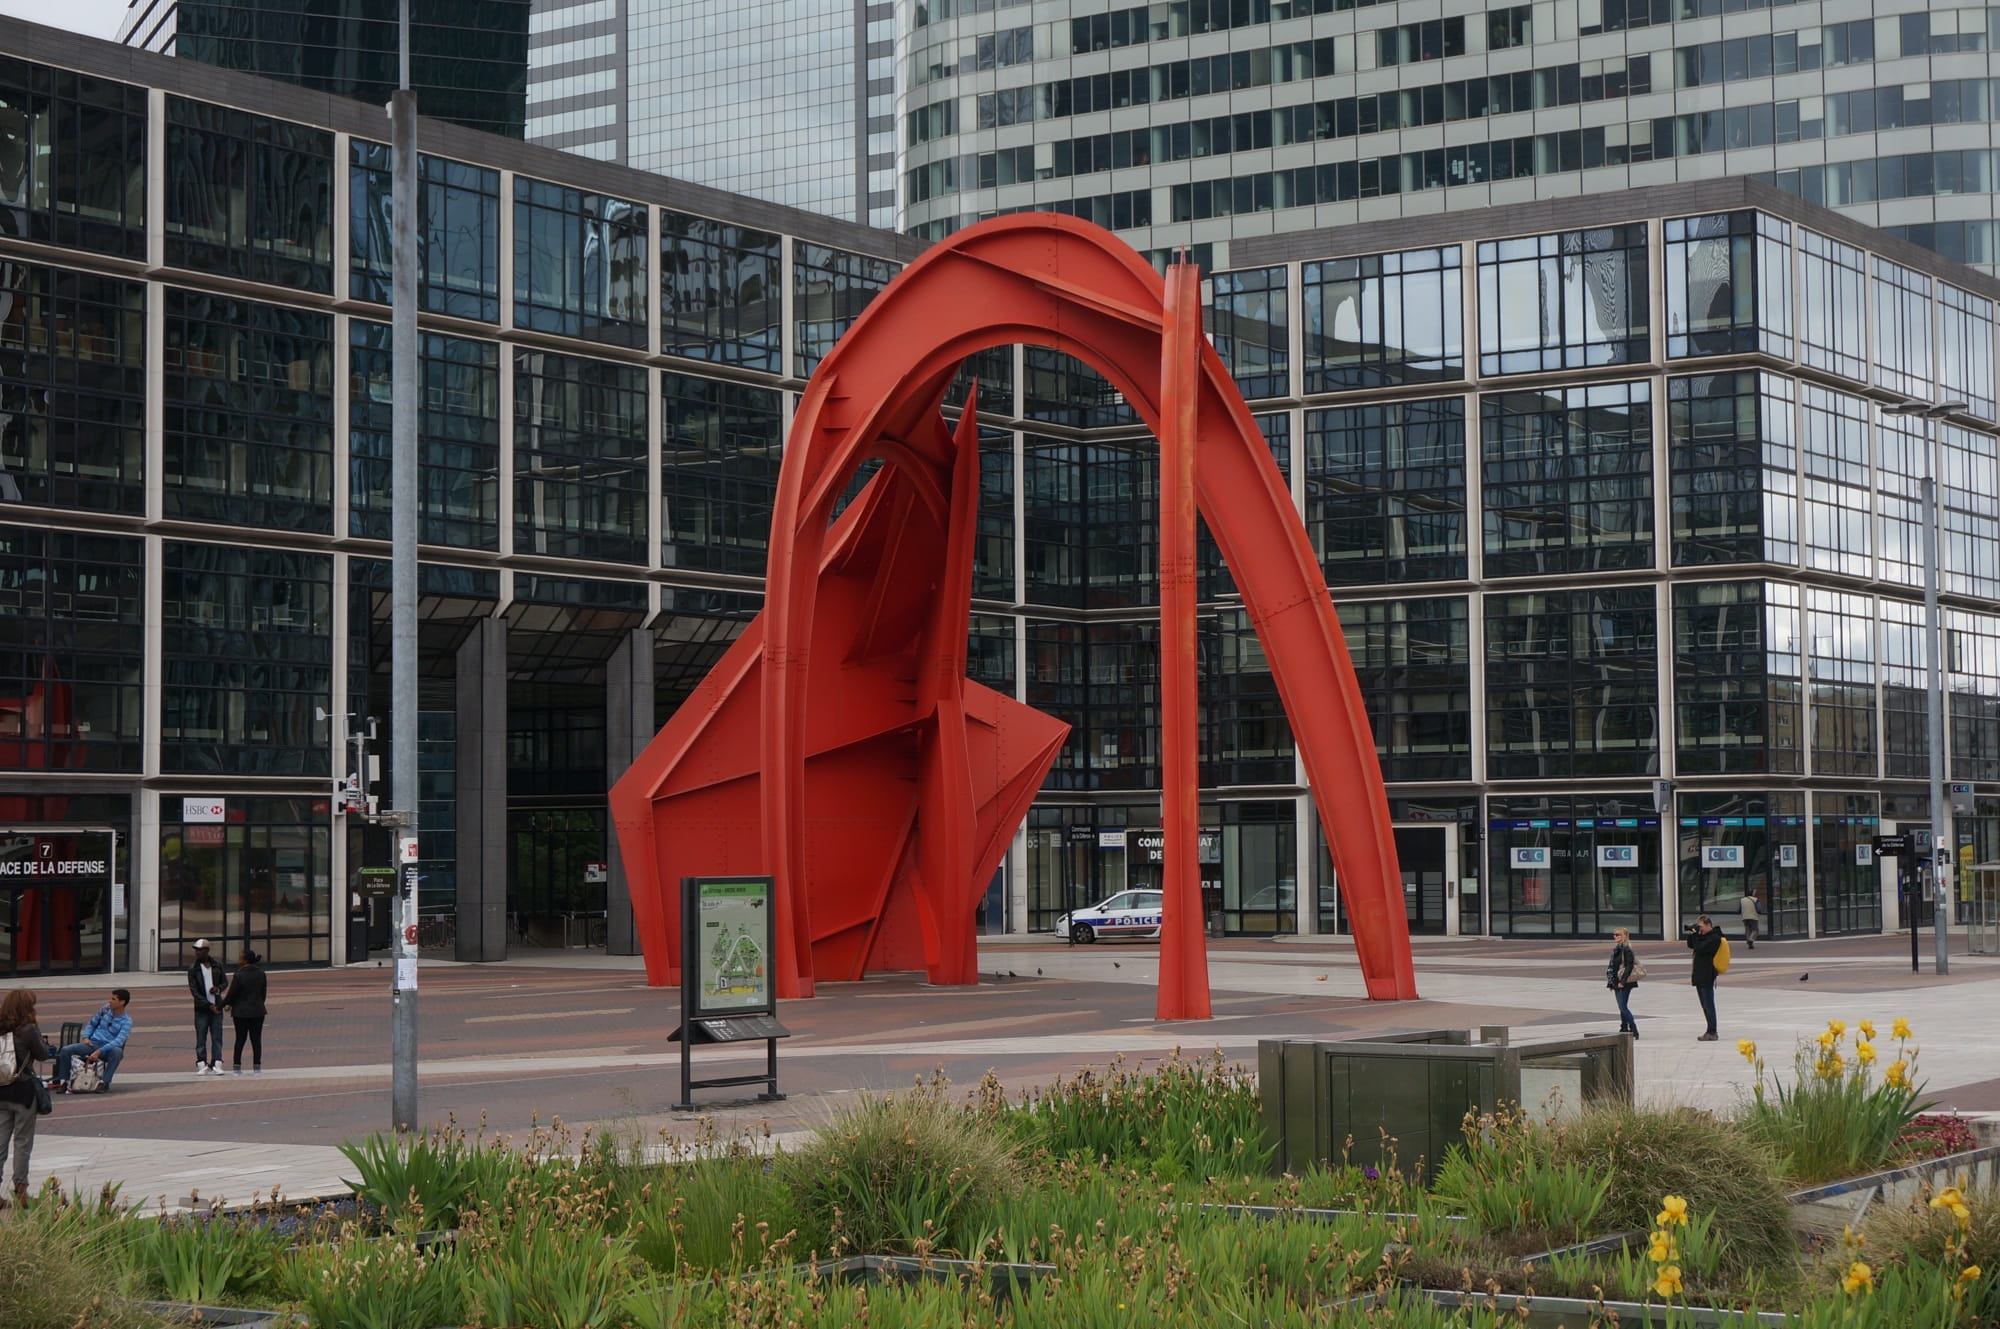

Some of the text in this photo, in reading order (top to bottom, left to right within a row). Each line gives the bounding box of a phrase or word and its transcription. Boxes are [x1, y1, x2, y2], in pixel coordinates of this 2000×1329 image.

[185, 805, 208, 815] HSBC
[42, 845, 50, 856] 7
[1150, 851, 1162, 859] DE
[1519, 850, 1543, 861] CIC
[1605, 849, 1631, 860] CIC
[1710, 849, 1735, 860] CIC
[24, 862, 38, 874] DE
[41, 862, 55, 874] LA
[58, 861, 104, 873] DEFENSE
[1115, 917, 1157, 925] POLICE
